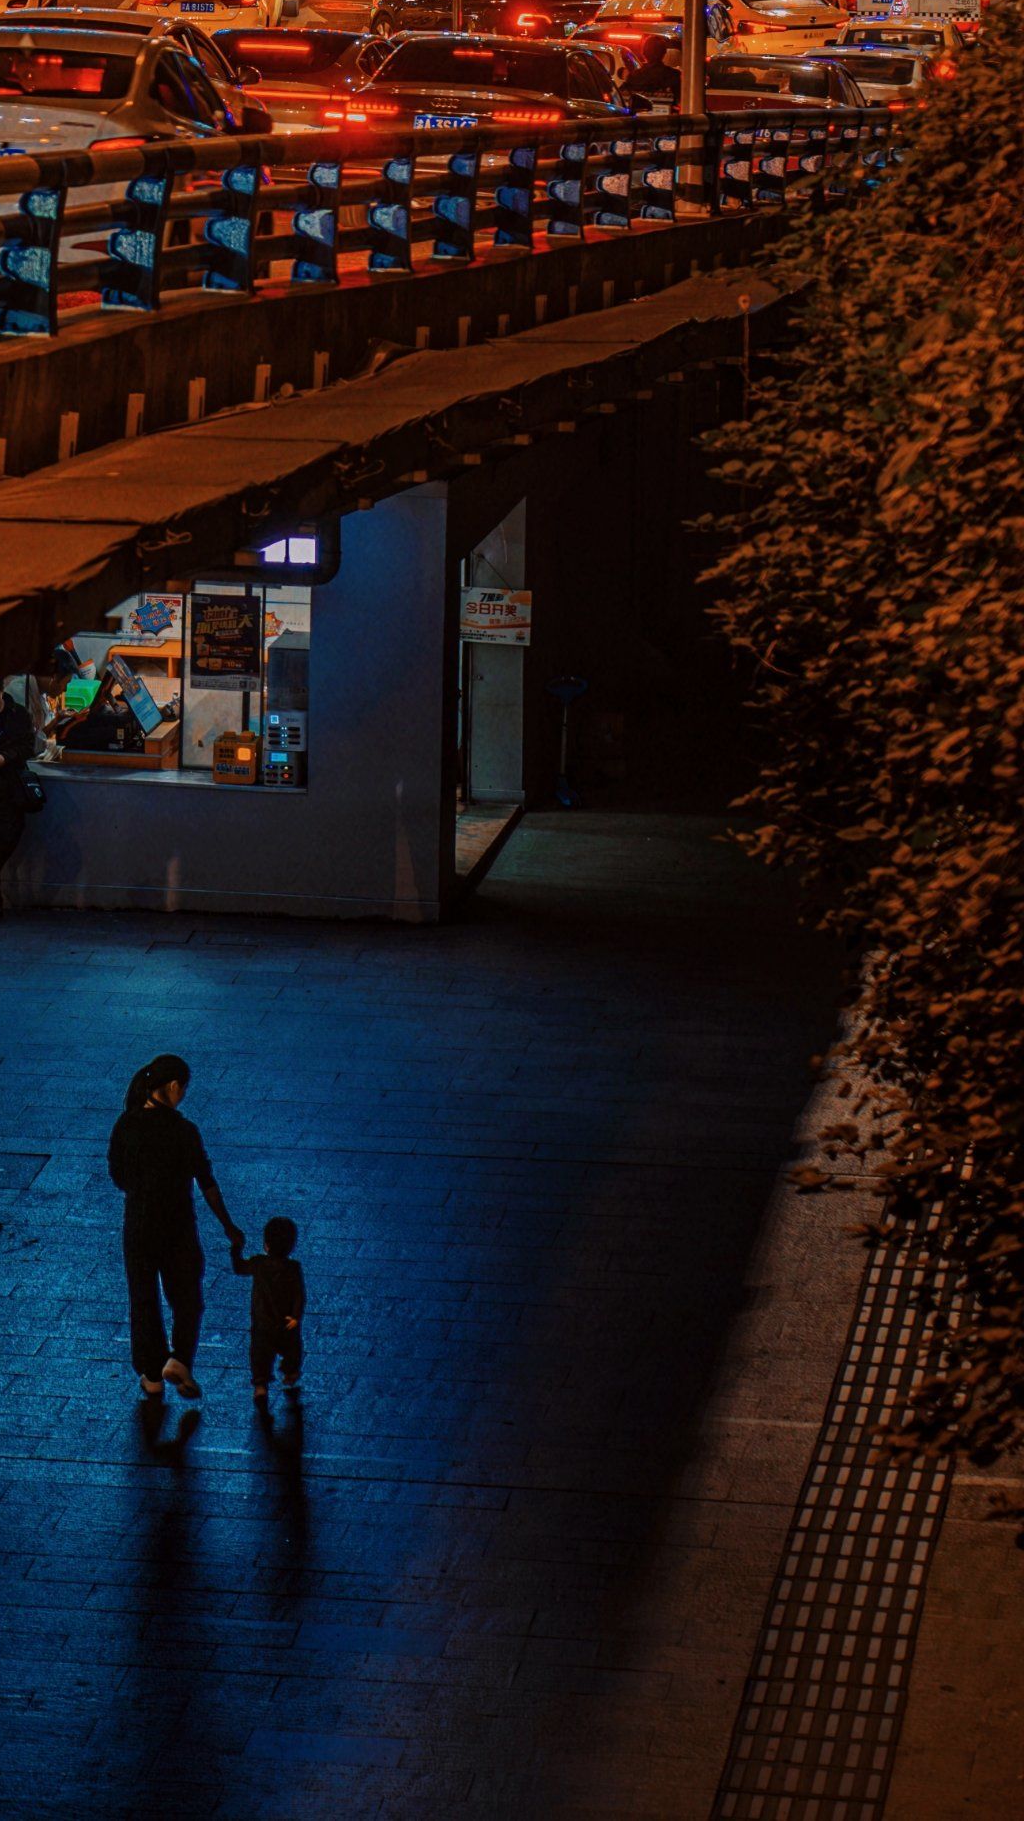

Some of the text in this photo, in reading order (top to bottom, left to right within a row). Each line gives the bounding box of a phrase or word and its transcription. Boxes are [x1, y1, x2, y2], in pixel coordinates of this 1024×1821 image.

[181, 2, 215, 12] A815T5
[465, 602, 518, 617] 今日开奖
